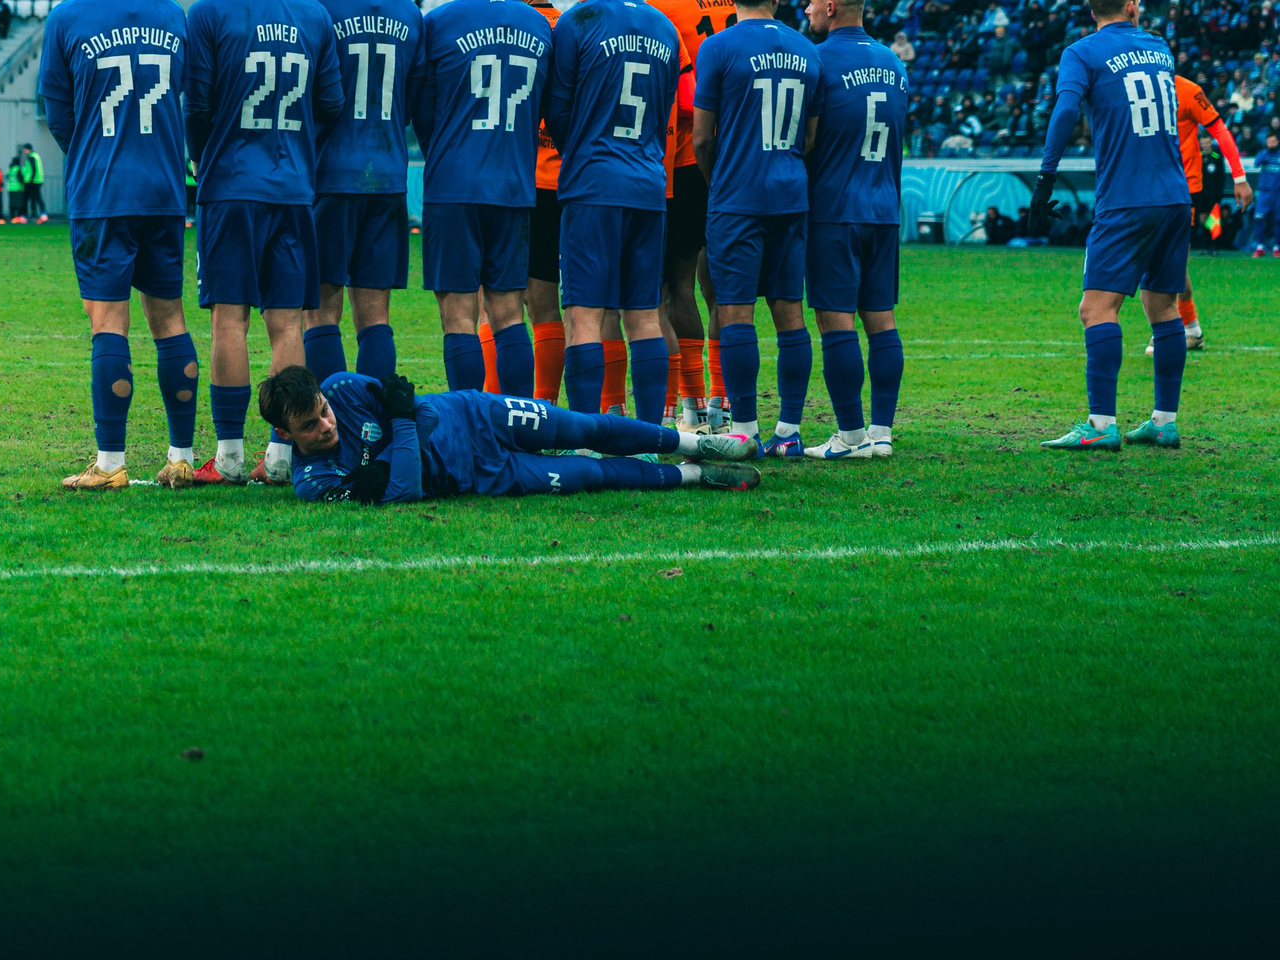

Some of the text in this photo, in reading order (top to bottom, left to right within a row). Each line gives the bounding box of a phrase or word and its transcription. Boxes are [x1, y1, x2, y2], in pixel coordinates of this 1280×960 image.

[81, 27, 180, 59] ЭЛЬДАРУШЕВ
[256, 24, 298, 44] АЛИЕВ
[333, 16, 409, 41] КЛЕЩЕНКО
[456, 27, 545, 58] ПОКИДЫШЕВ
[600, 35, 671, 64] ТРОШЕЧКИН
[97, 54, 171, 137] 77
[240, 51, 309, 131] 22
[348, 43, 396, 120] 11
[471, 54, 538, 132] 97
[750, 53, 807, 73] СИМОНЯН
[841, 67, 896, 89] МАКАРОВ
[613, 62, 651, 139] 5
[753, 78, 805, 151] 10
[860, 92, 889, 161] 6
[1123, 71, 1179, 137] 80
